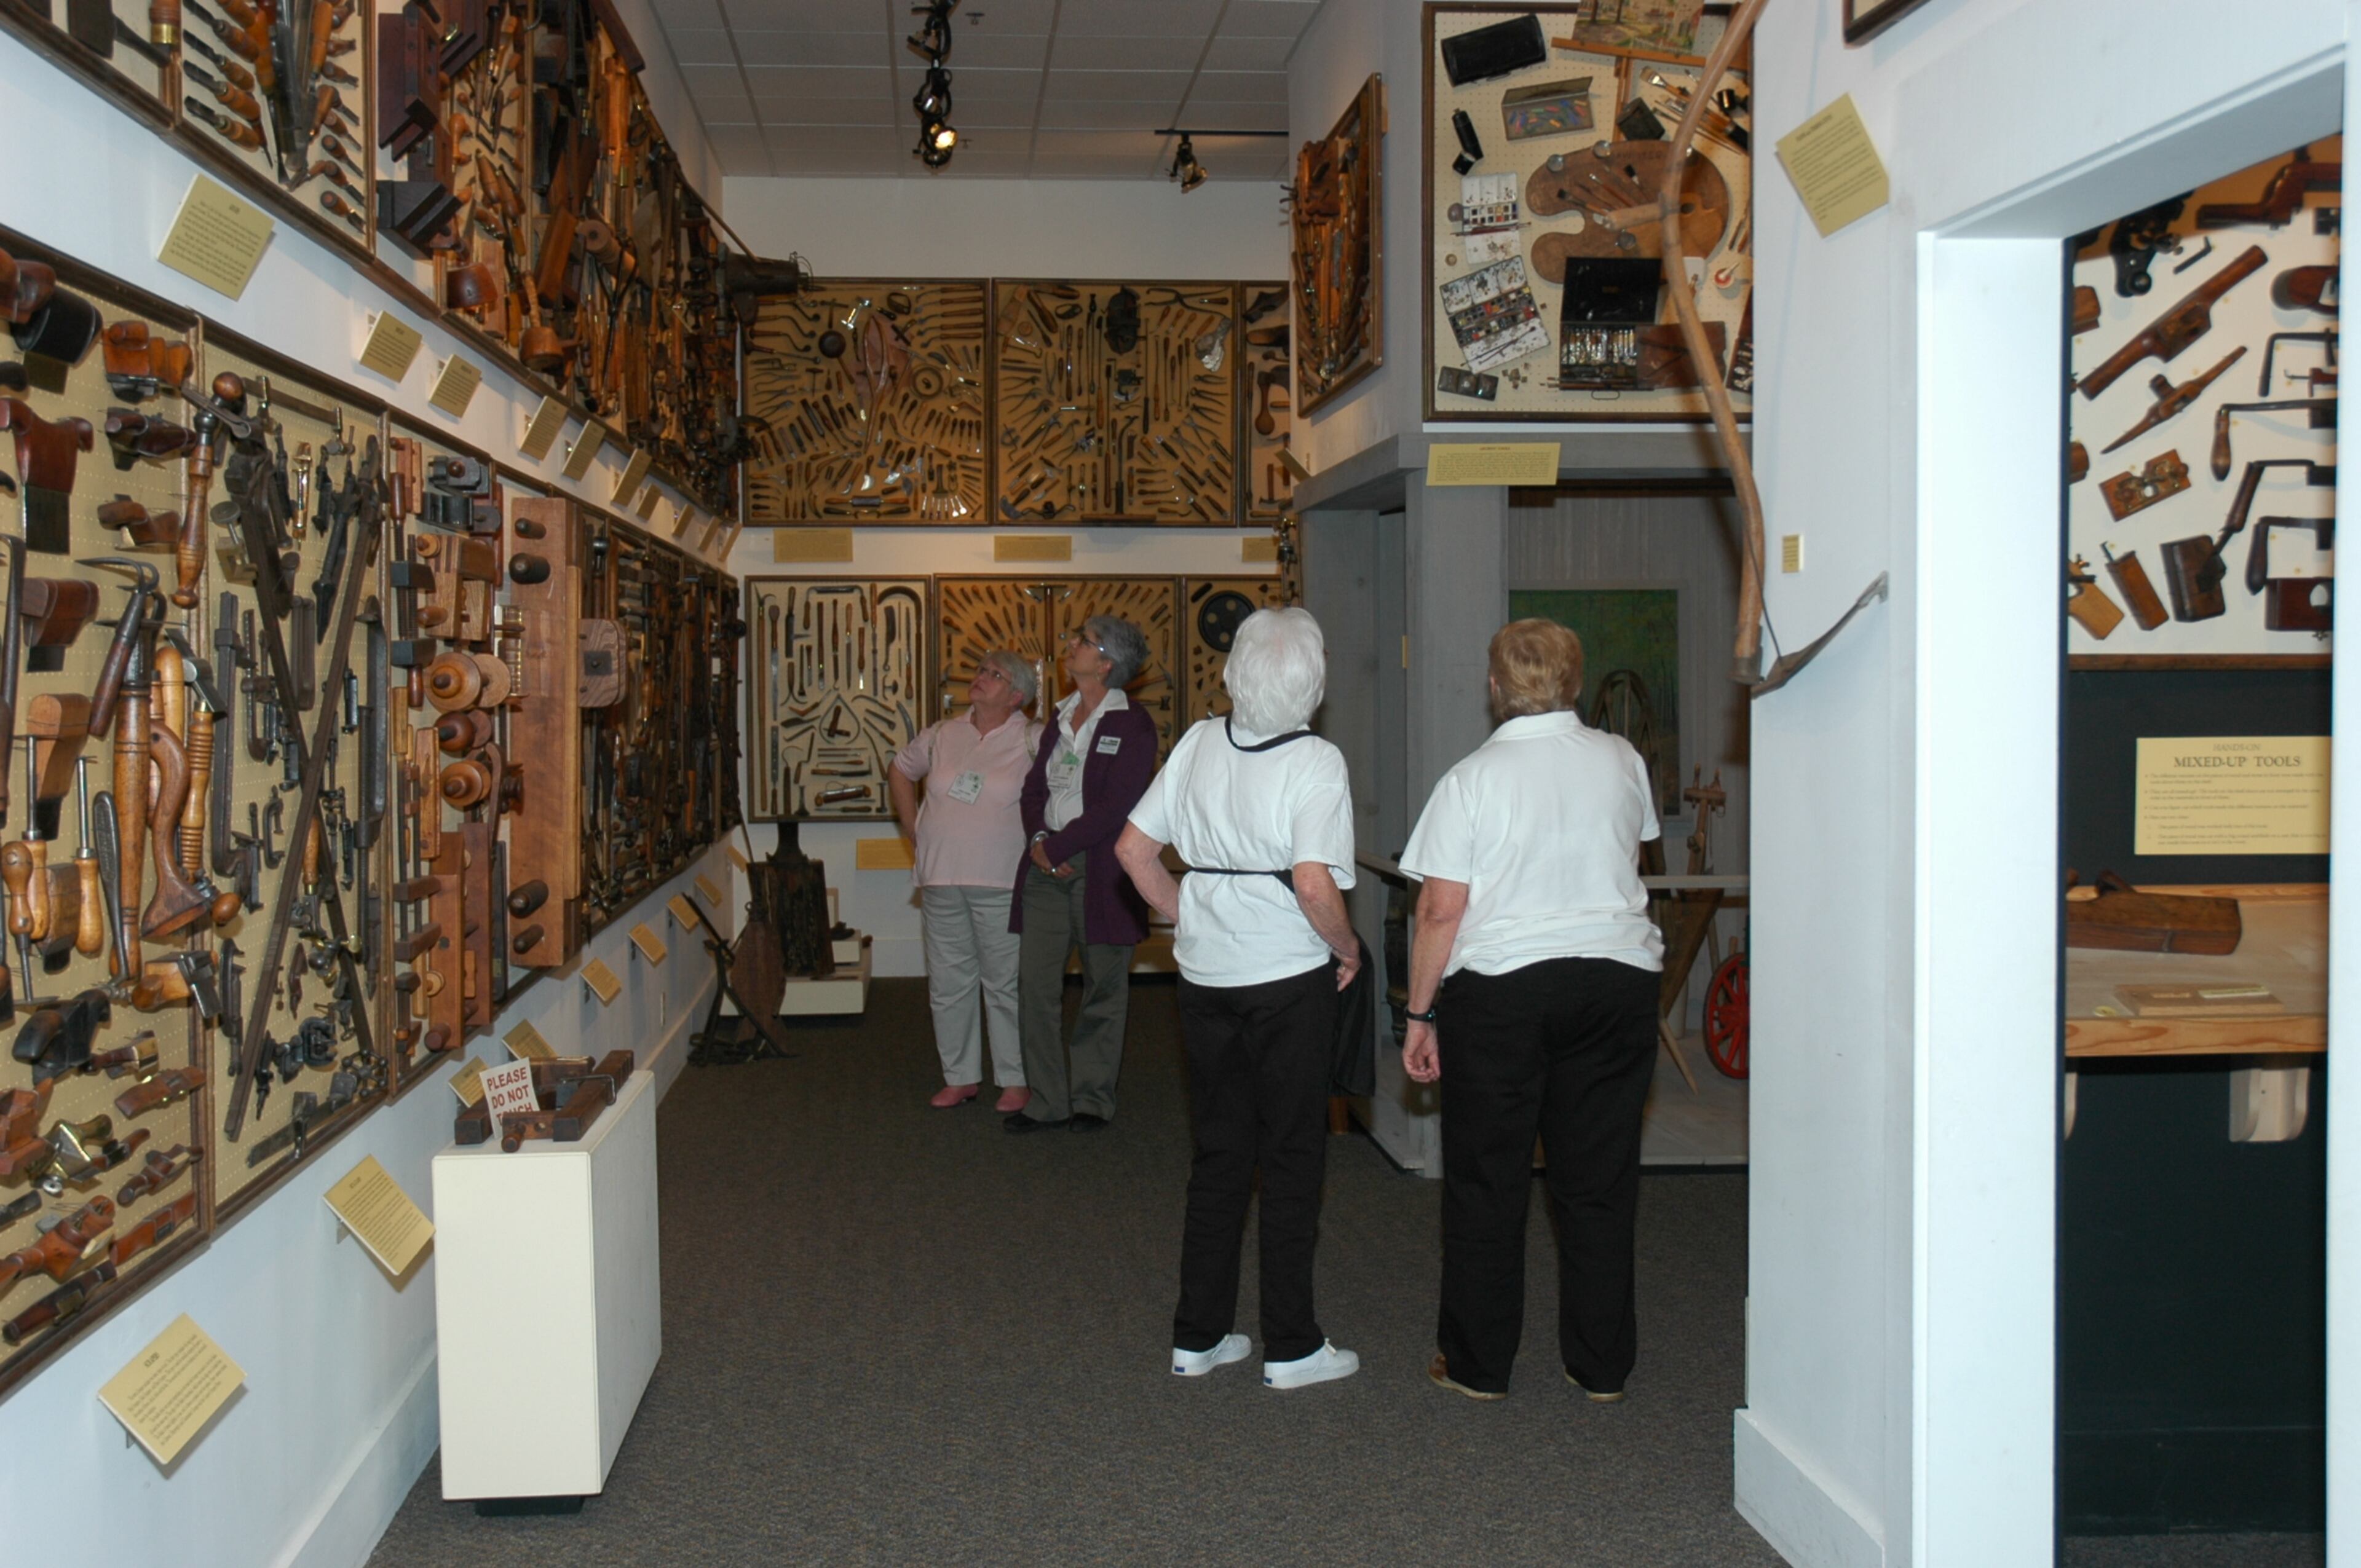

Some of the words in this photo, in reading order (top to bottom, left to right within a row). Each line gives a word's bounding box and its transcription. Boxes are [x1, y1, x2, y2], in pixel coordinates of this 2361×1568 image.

[2174, 756, 2246, 768] MIXED-UP
[2253, 755, 2301, 767] TOOLS
[487, 1067, 527, 1091] PLEASE
[492, 1093, 505, 1109] DO
[507, 1084, 529, 1103] NOT
